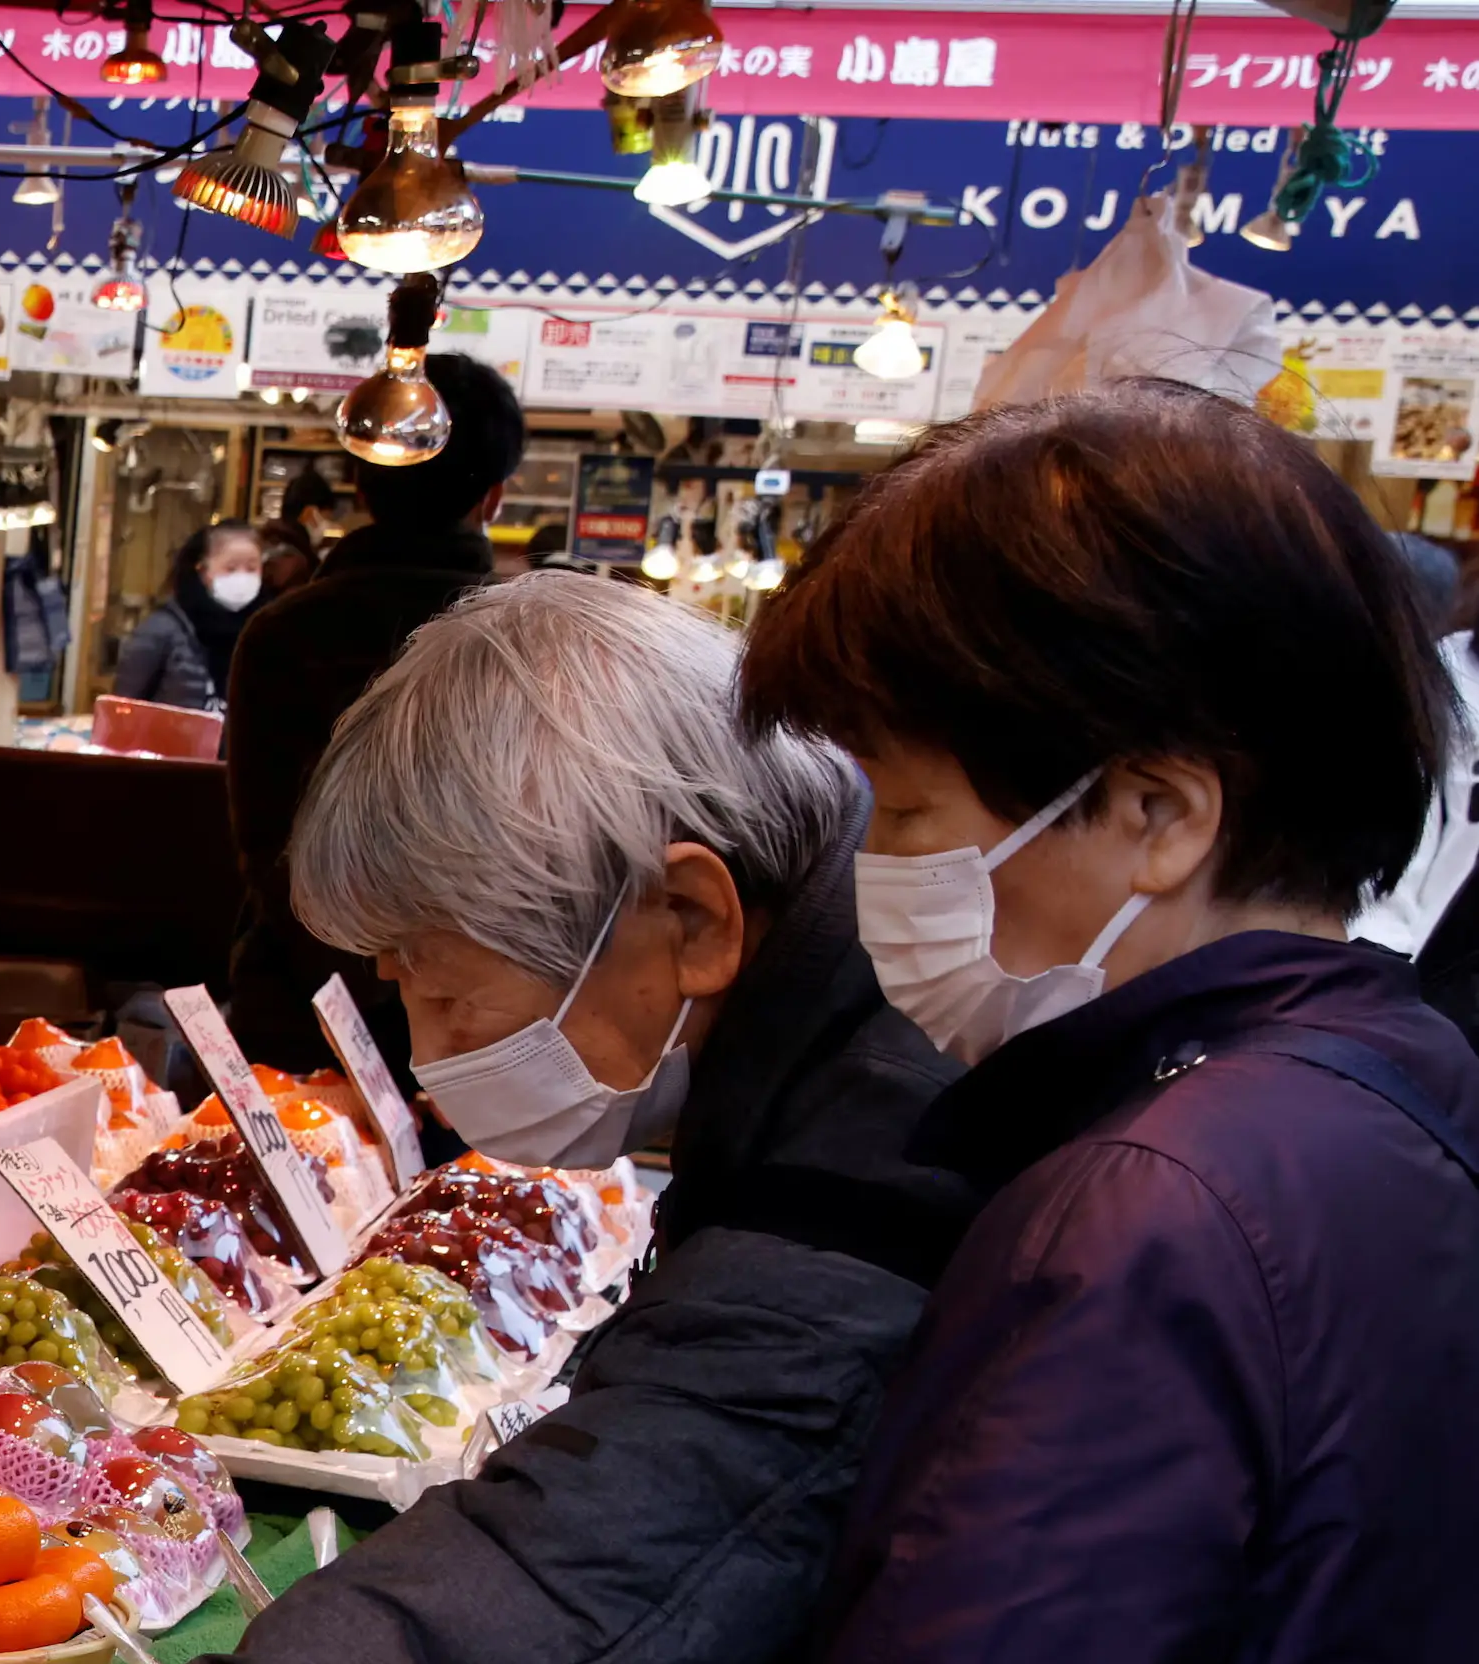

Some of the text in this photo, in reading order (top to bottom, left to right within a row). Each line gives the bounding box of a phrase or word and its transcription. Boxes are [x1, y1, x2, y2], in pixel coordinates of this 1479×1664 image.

[837, 36, 998, 87] 小島屋
[1006, 121, 1098, 149] Nuts
[1115, 122, 1146, 150] &
[959, 185, 1421, 240] KOJMYA
